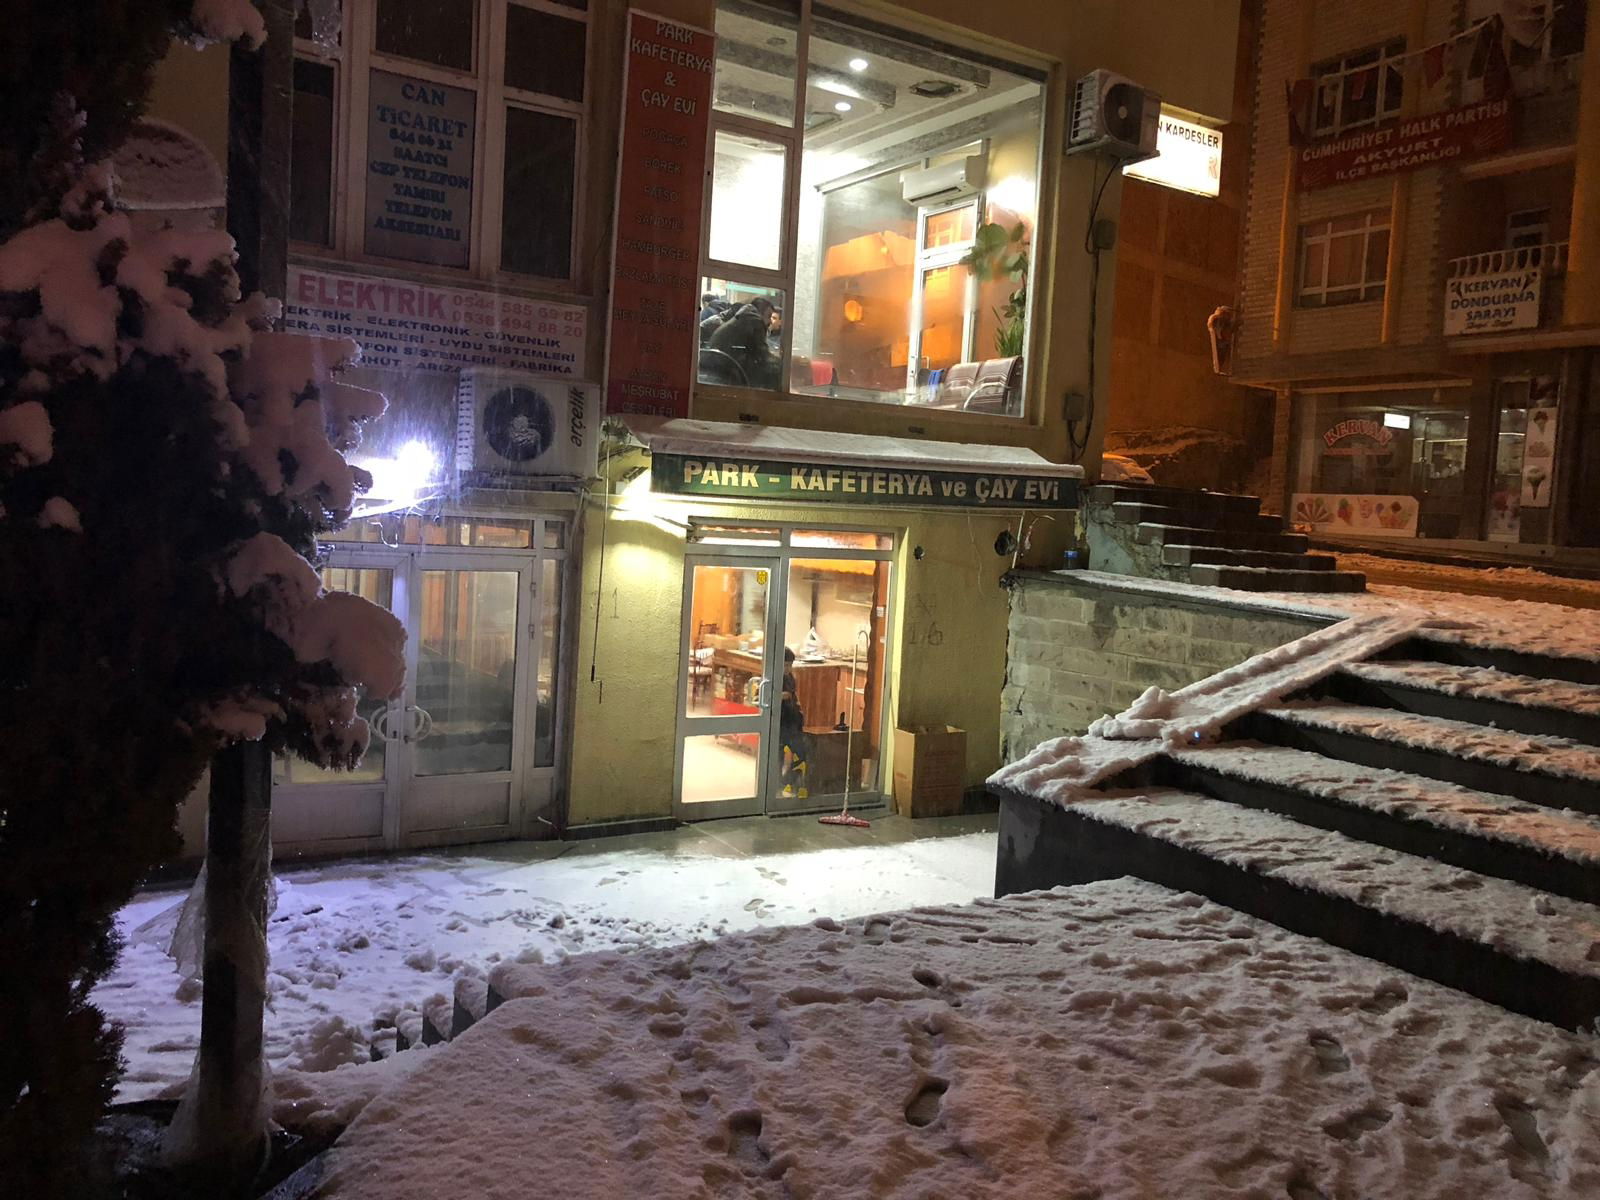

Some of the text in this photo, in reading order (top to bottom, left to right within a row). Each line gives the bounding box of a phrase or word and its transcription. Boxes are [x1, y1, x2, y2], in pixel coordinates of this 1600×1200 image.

[656, 20, 694, 44] PARK
[631, 37, 713, 74] KAFETERYA
[664, 71, 677, 87] &
[401, 83, 447, 107] CAN
[641, 88, 670, 109] ÇAY
[1302, 128, 1394, 163] CUMHURİYET
[1400, 116, 1441, 139] HALK
[1352, 137, 1444, 166] AKYURT
[1464, 277, 1521, 293] KERVAN
[298, 273, 447, 320] ELEKTRİK
[1451, 291, 1535, 309] DONDURMA
[1466, 307, 1516, 321] SARAYI
[367, 316, 470, 337] ELEKTRONİK
[564, 325, 583, 338] 20
[440, 338, 483, 350] UYDU
[570, 387, 586, 448] arçelik
[684, 461, 759, 488] PARK
[790, 467, 933, 496] KAFETERYA
[941, 480, 967, 496] ve
[975, 477, 1019, 503] ÇAY
